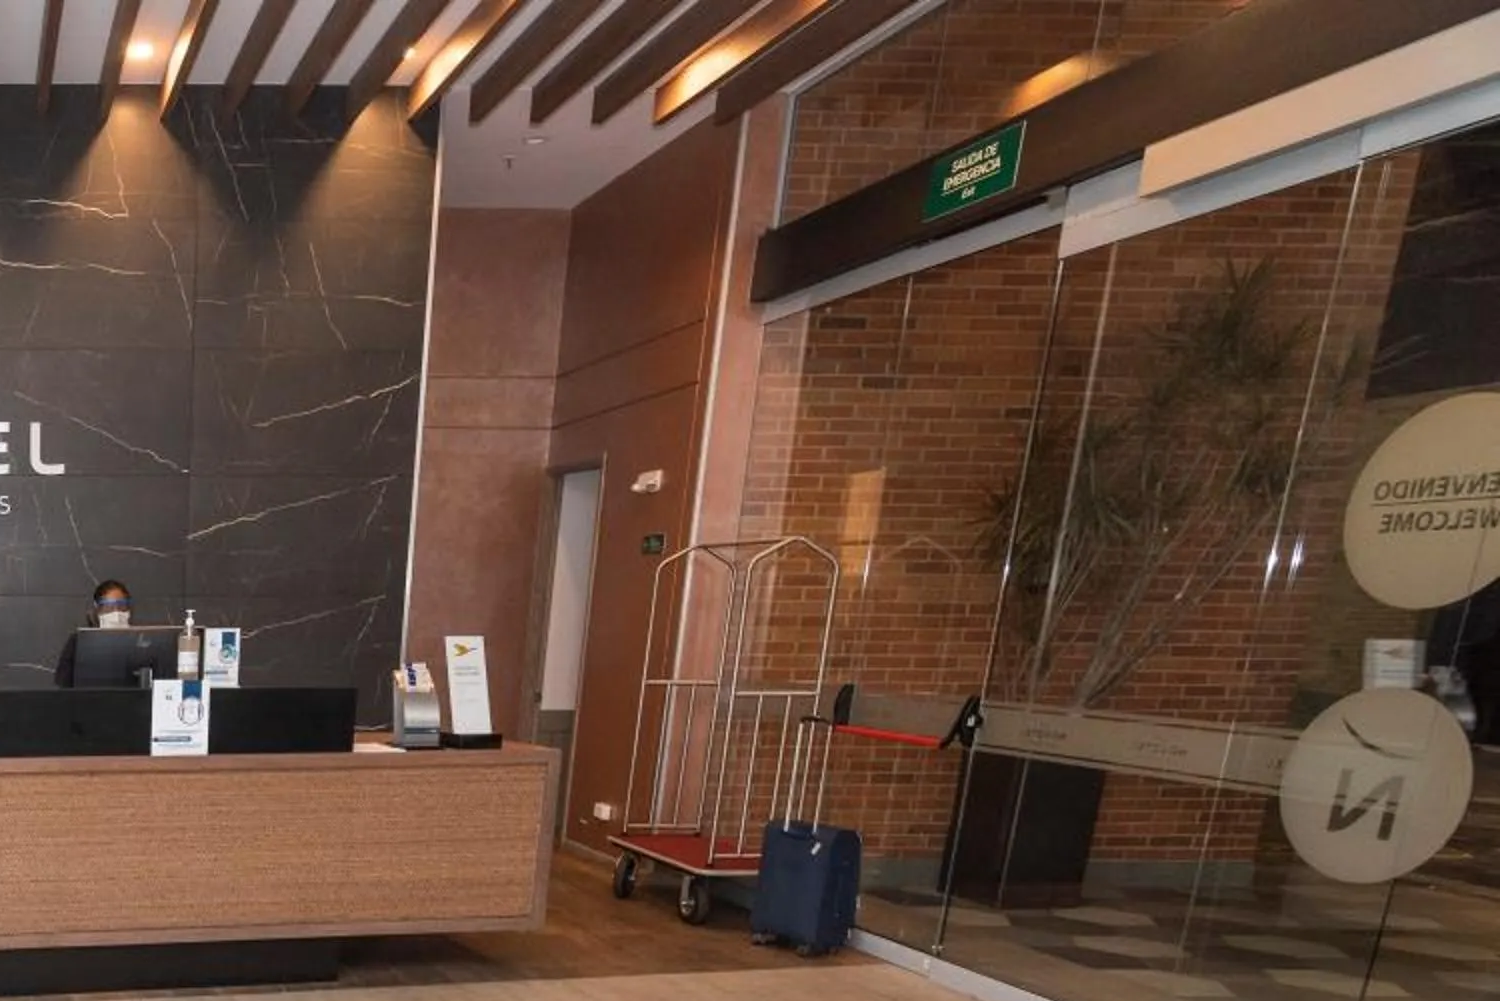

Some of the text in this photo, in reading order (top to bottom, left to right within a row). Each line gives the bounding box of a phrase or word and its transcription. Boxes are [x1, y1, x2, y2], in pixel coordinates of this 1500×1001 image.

[943, 155, 1001, 190] EMERGENCIA
[951, 142, 999, 173] SALIDA DE
